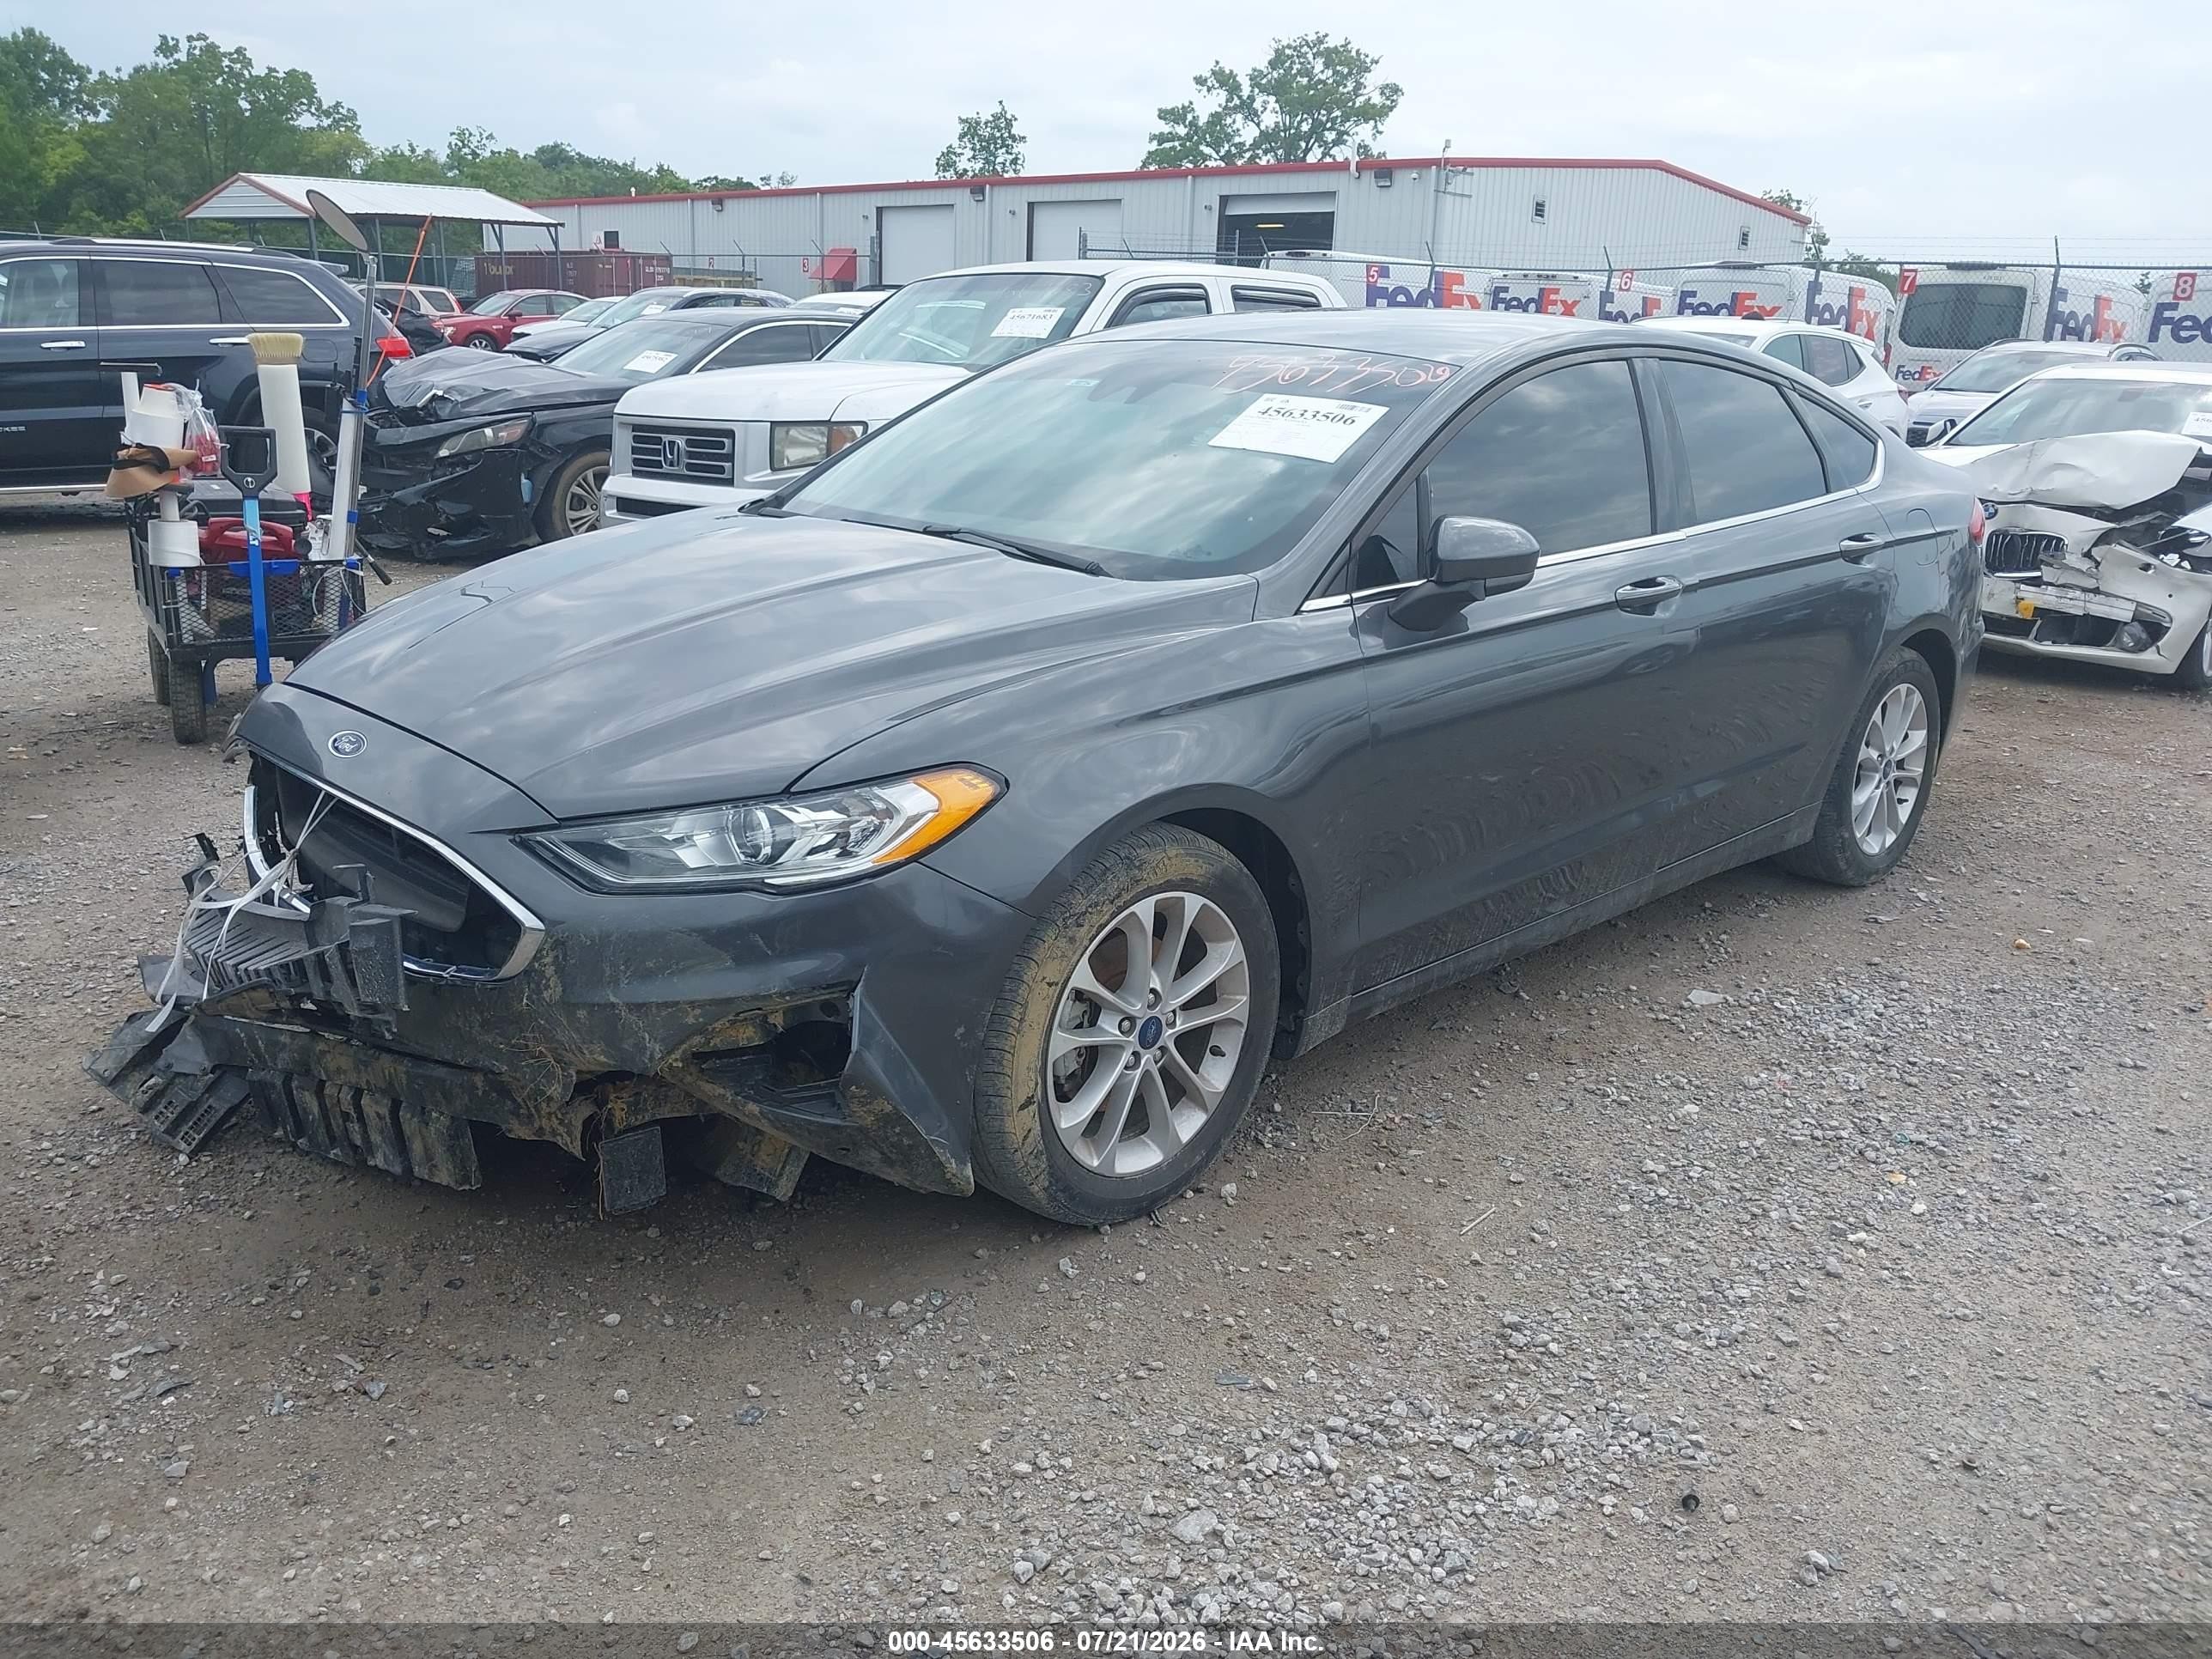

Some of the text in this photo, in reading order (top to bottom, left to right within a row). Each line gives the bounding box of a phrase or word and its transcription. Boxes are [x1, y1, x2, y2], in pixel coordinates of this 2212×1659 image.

[803, 259, 808, 270] 3
[1368, 266, 1379, 283] 5
[1620, 272, 1632, 289] 6
[1903, 271, 1916, 291] 7
[2176, 276, 2193, 298] 8
[1491, 286, 1580, 317] FedEx
[1677, 290, 1783, 317] FedEx
[1805, 280, 1881, 341] FedEx
[1257, 406, 1360, 426] 45633506
